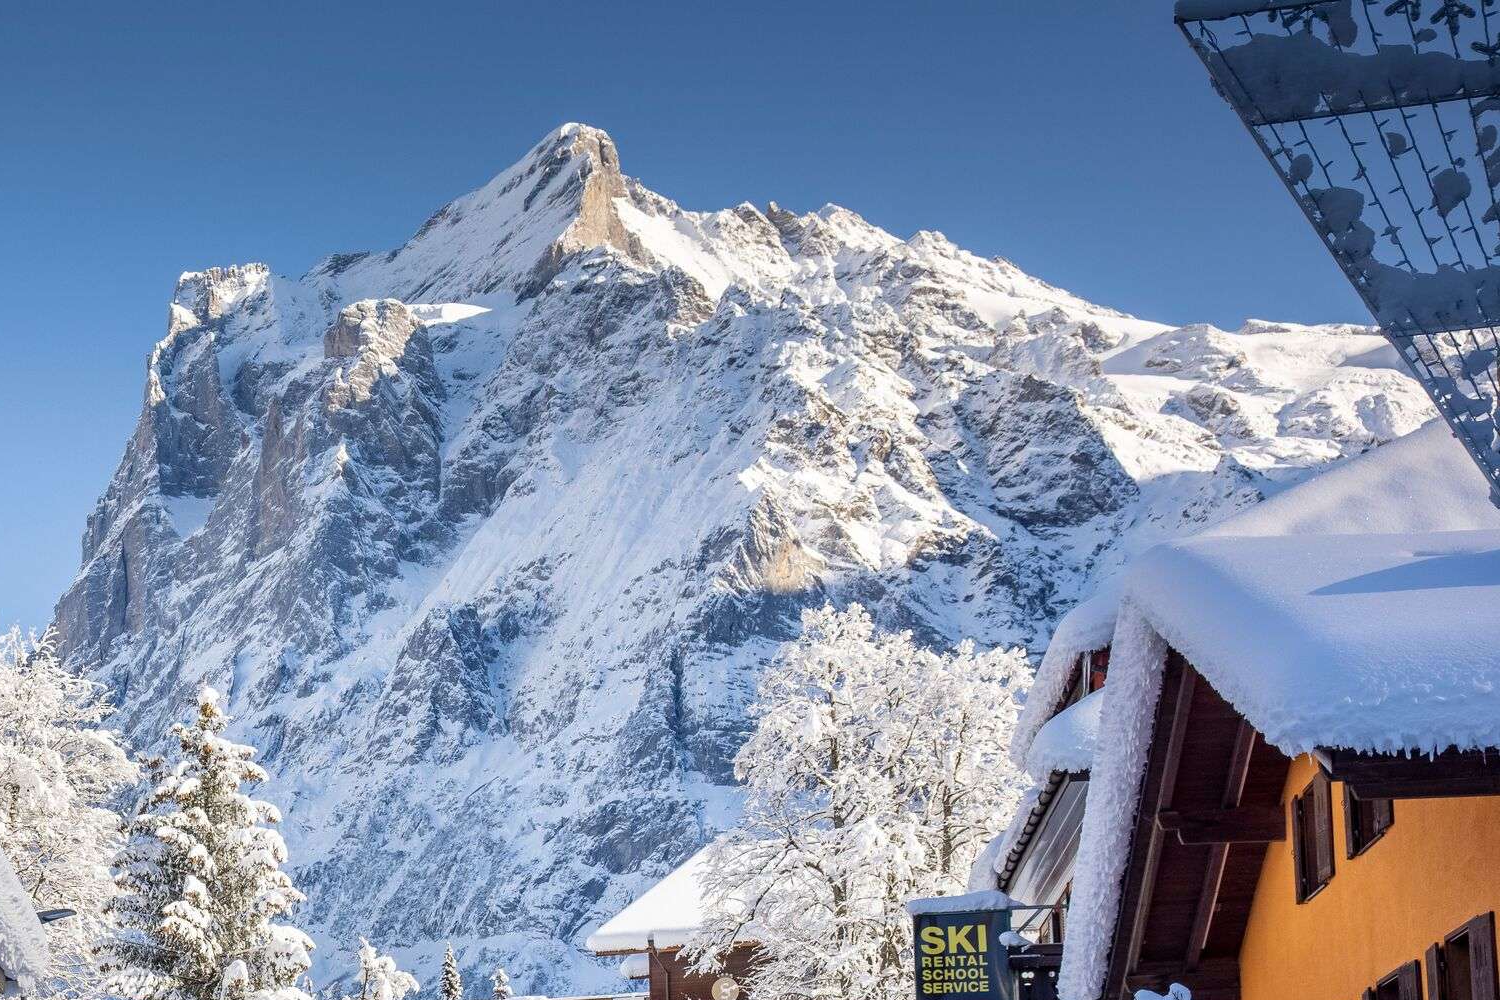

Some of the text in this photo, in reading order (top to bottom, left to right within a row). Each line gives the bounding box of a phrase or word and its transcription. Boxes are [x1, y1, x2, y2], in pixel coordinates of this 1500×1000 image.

[920, 924, 988, 955] SKI
[921, 955, 989, 968] RENTAL
[922, 968, 989, 981] SCHOOL
[922, 981, 990, 994] SERVICE
